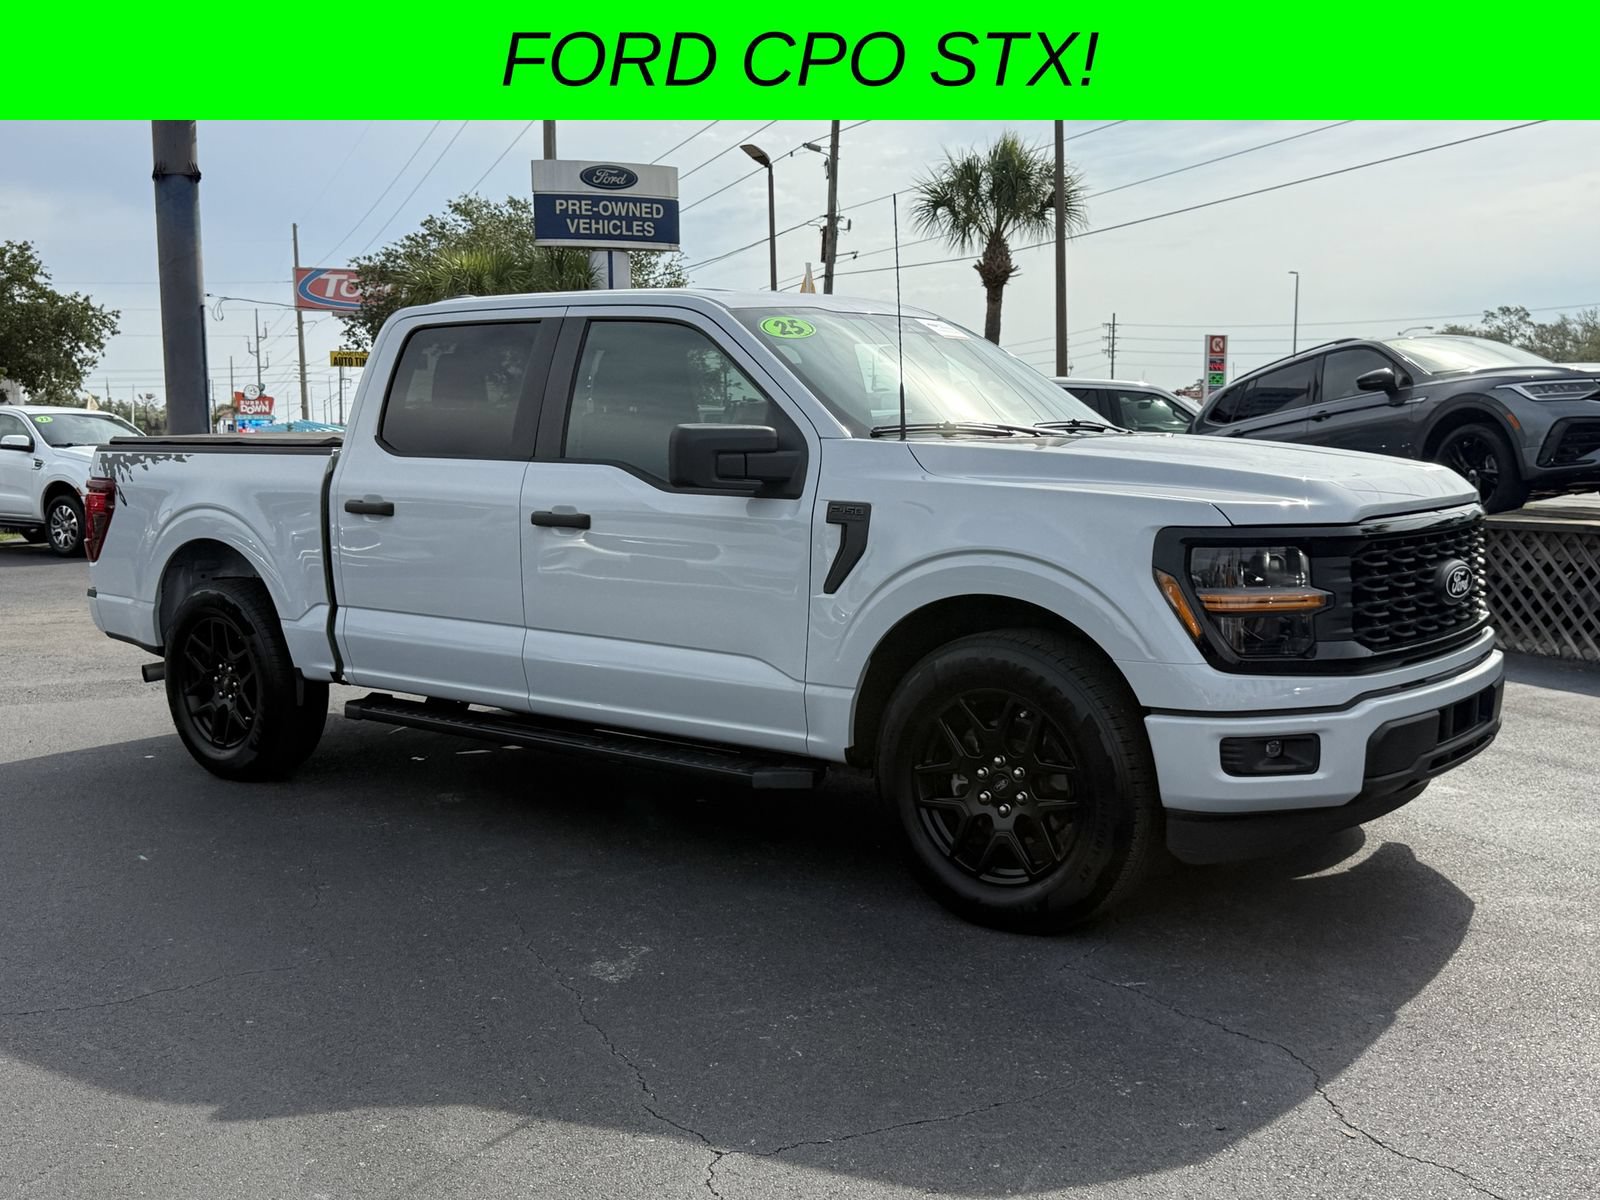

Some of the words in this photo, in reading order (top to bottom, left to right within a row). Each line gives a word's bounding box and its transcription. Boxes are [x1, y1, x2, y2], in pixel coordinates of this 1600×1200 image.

[593, 168, 627, 184] Ford
[555, 200, 664, 218] PRE-OWNED
[566, 219, 655, 237] VEHICLES
[773, 320, 804, 335] 25
[333, 357, 353, 367] AUTO
[240, 404, 269, 414] DOWN
[1452, 571, 1469, 593] Ford
